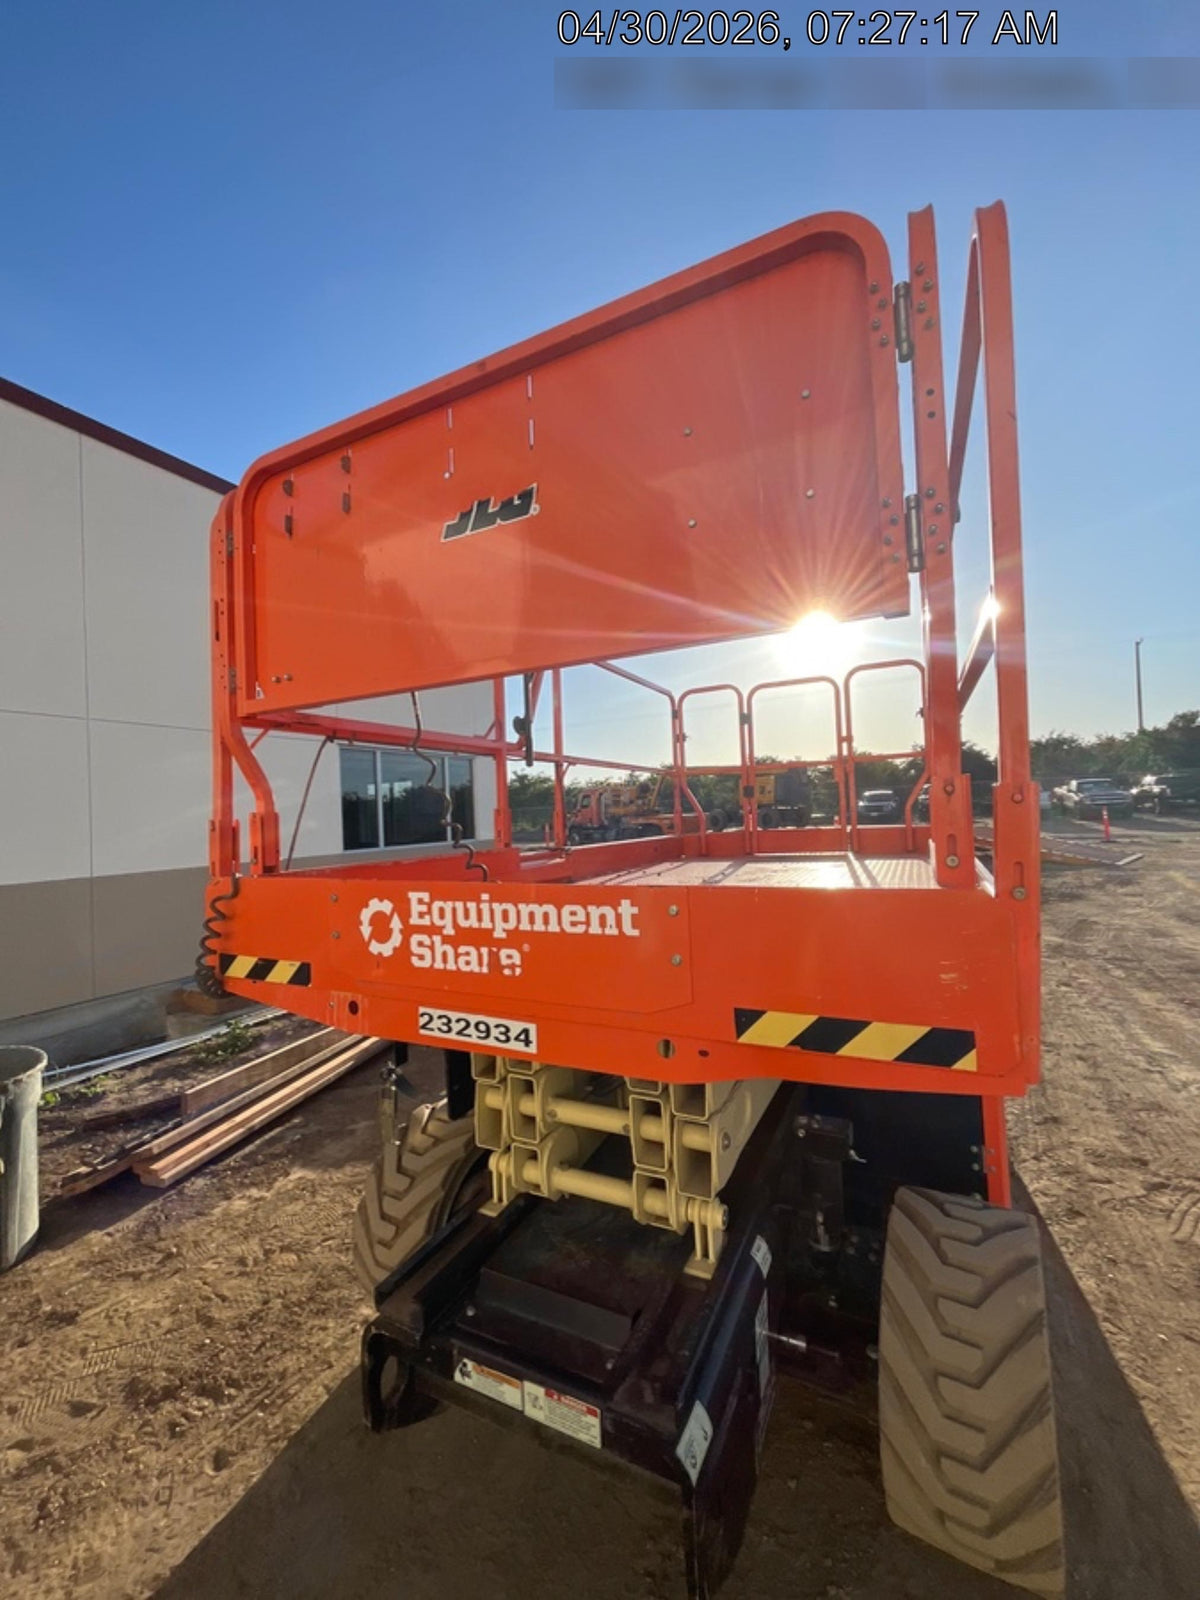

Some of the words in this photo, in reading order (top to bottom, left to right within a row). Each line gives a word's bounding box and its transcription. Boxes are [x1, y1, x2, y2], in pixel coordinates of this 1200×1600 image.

[440, 483, 538, 542] JLG
[408, 891, 640, 938] Equipment
[419, 1012, 533, 1048] 232934
